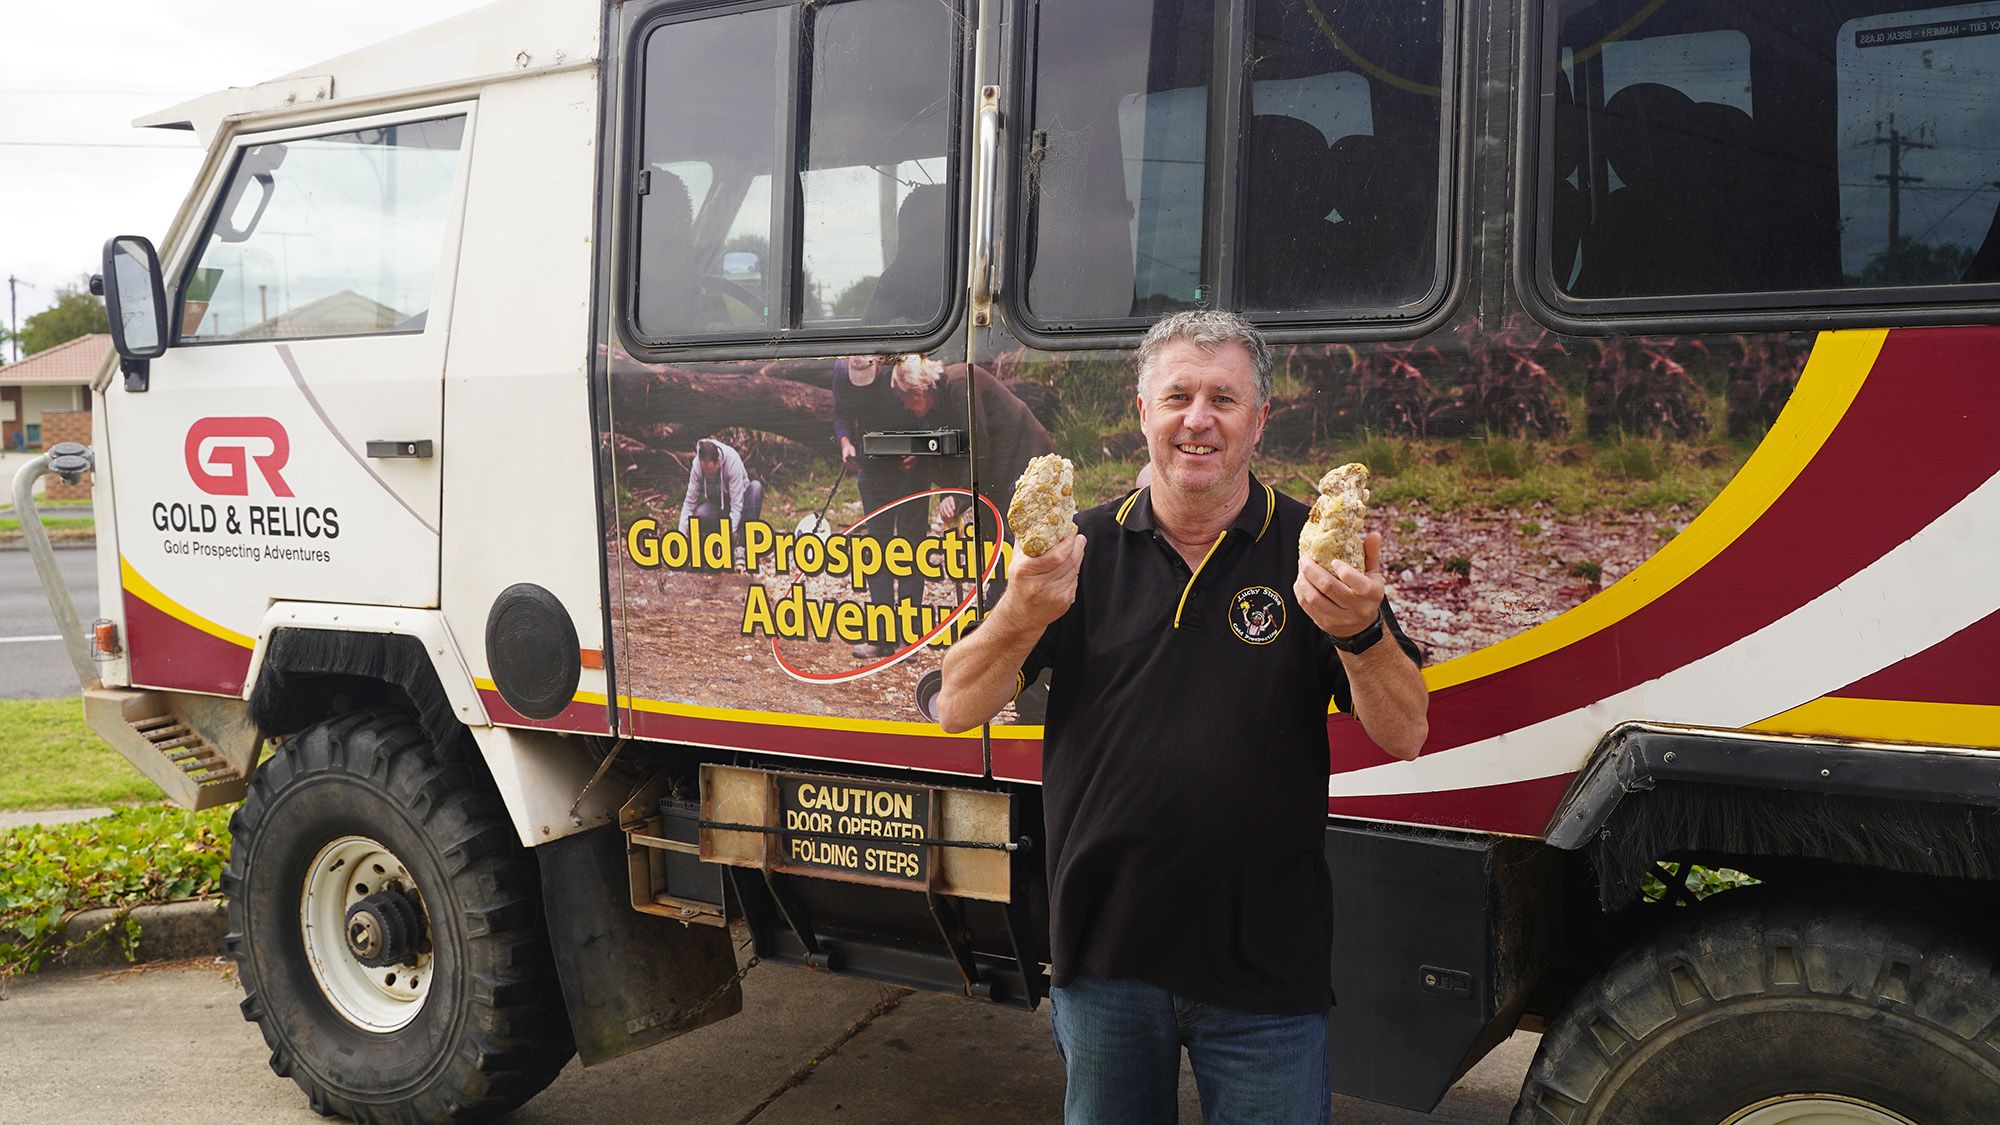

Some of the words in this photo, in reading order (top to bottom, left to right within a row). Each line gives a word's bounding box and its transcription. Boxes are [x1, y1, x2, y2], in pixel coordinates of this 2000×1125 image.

[184, 416, 296, 498] GR
[152, 502, 217, 533] GOLD
[225, 504, 242, 535] &
[249, 505, 340, 539] RELICS
[163, 539, 189, 556] Gold
[192, 541, 260, 562] Prospecting
[264, 544, 331, 563] Adventures
[628, 517, 732, 570] Gold
[745, 520, 1013, 588] Prospectin
[1237, 588, 1260, 603] Lucky
[1262, 589, 1282, 606] Strike
[1232, 622, 1244, 637] Gold
[1244, 629, 1278, 642] Prospecting
[797, 783, 914, 820] CAUTION
[786, 809, 833, 833] DOOR
[838, 815, 925, 847] OPERATED
[791, 838, 858, 869] FOLDING
[864, 848, 920, 878] STEPS
